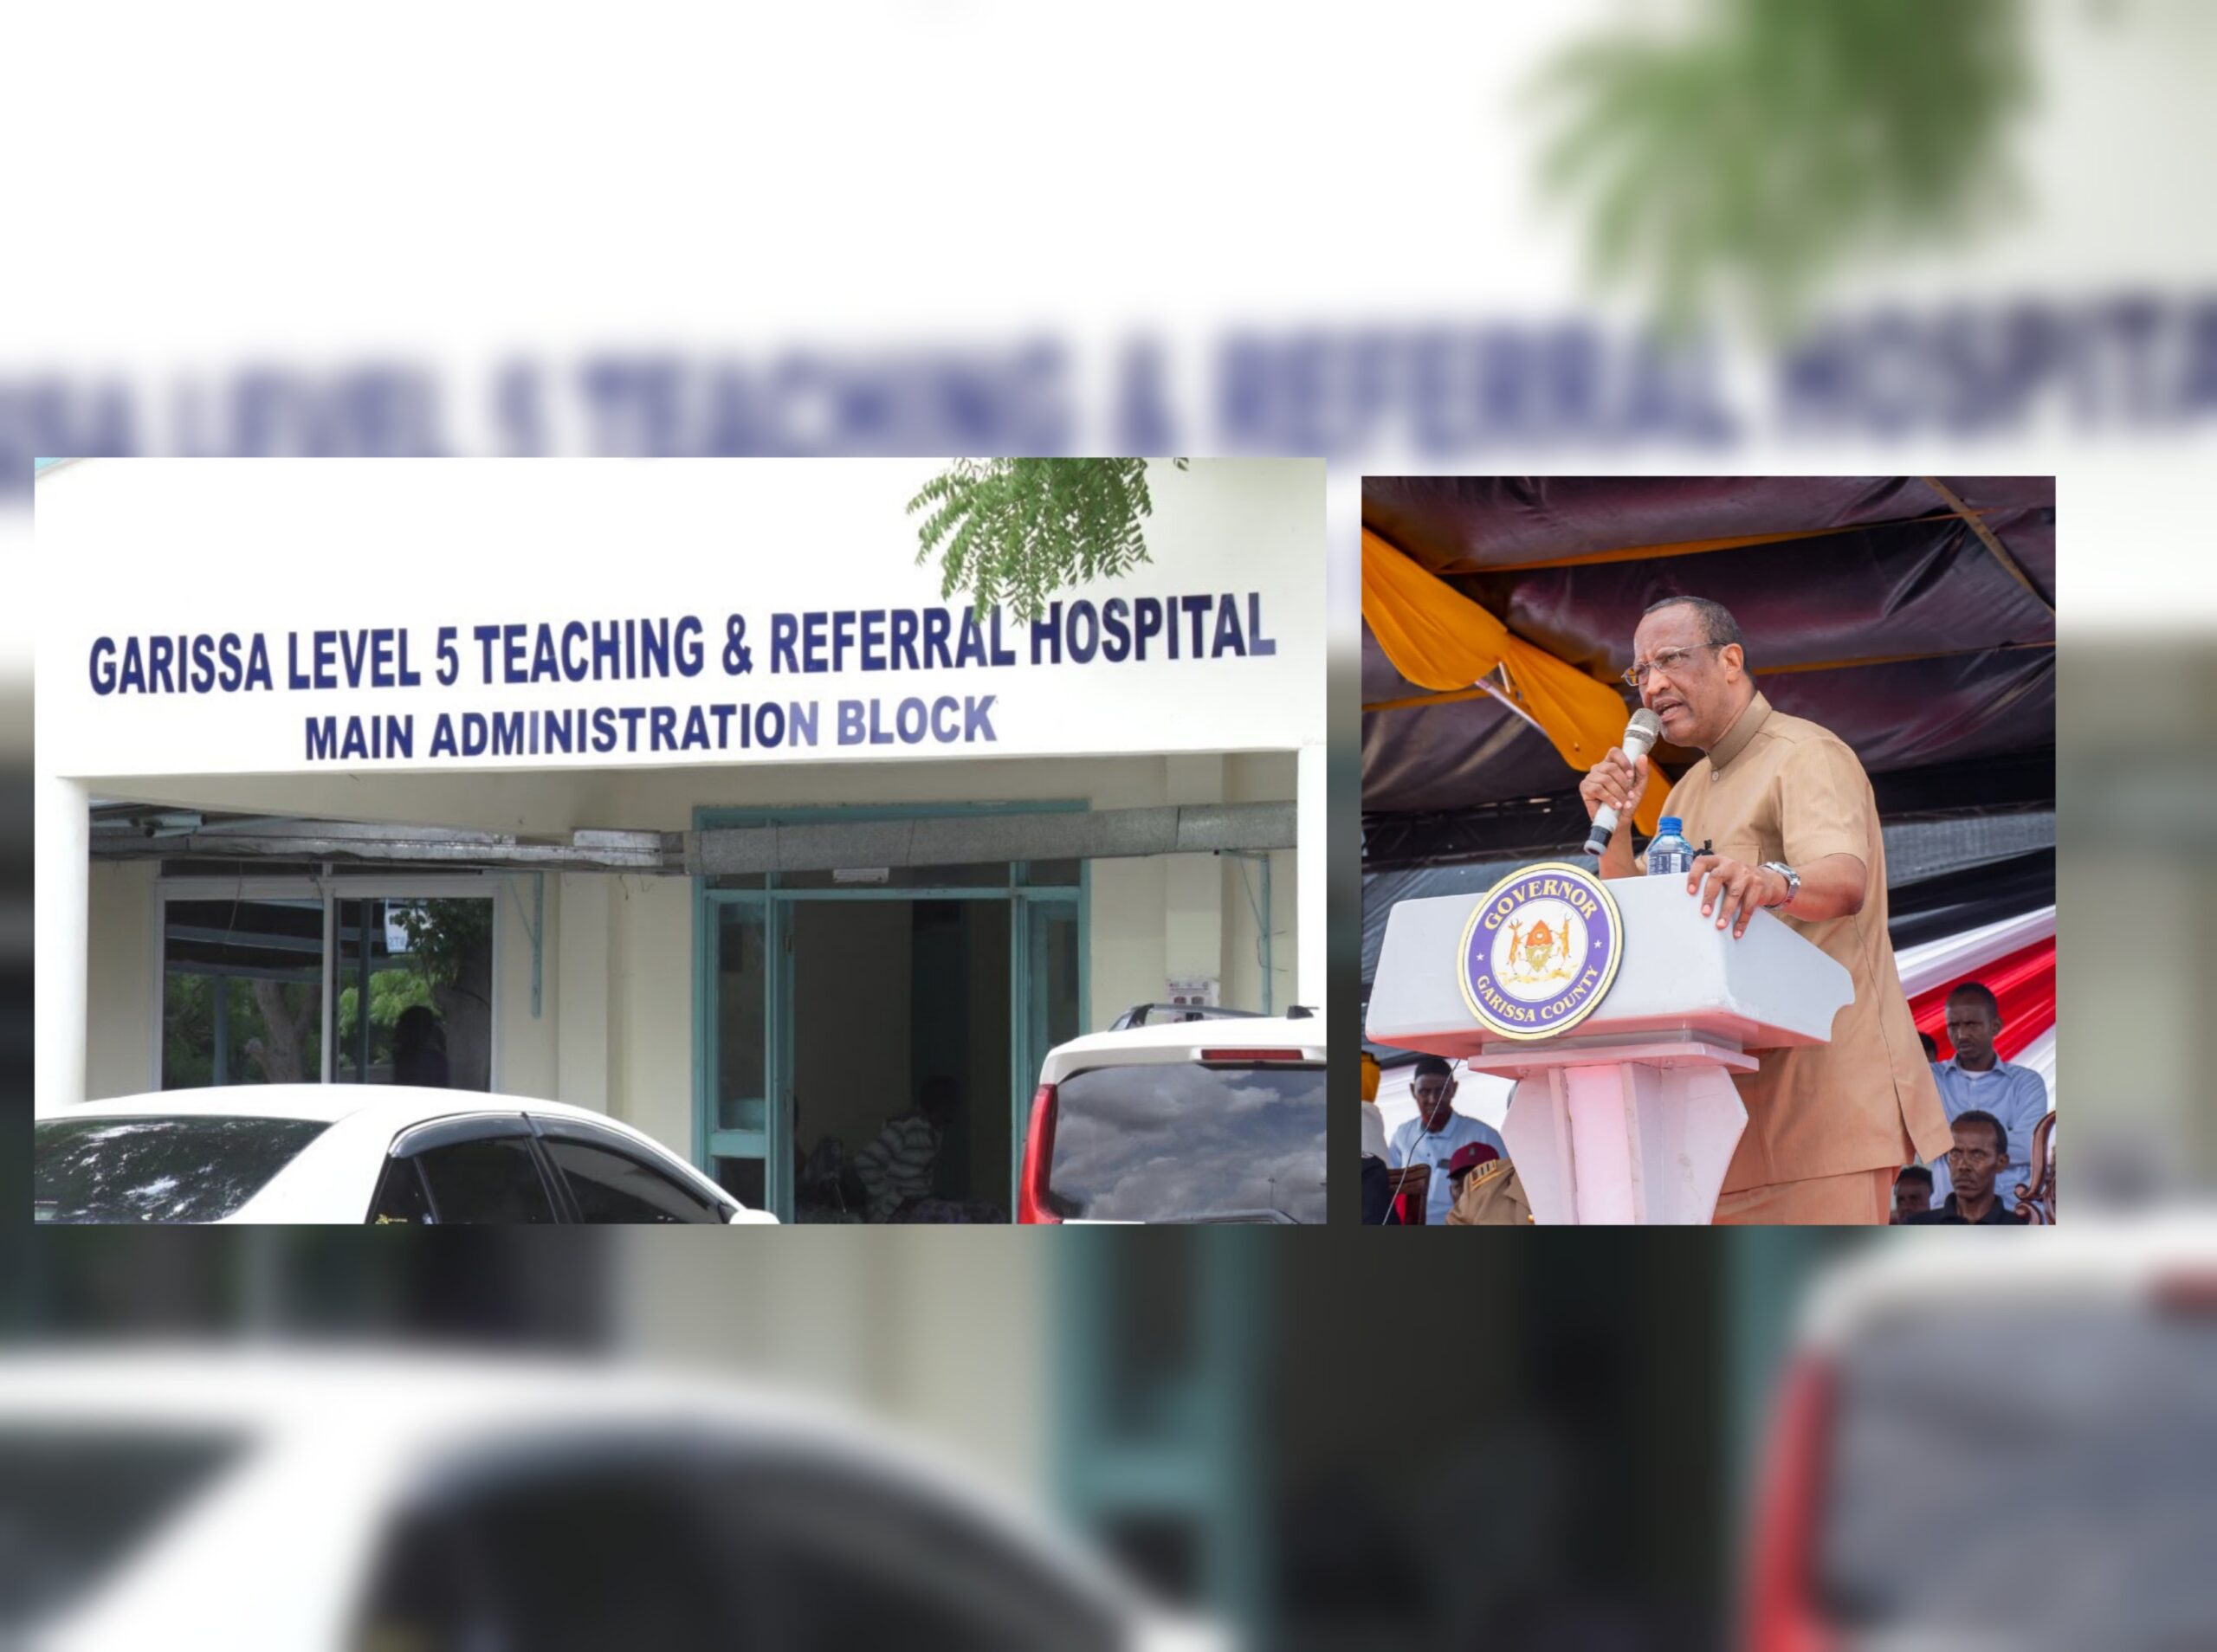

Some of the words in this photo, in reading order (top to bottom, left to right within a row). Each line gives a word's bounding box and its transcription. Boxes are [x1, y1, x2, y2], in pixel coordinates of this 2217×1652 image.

[90, 633, 273, 695] GARISSA
[288, 629, 421, 690] LEVEL
[436, 626, 460, 686] 5
[474, 616, 704, 684] TEACHING
[721, 613, 753, 675] &
[771, 604, 1016, 674] REFERRAL
[1031, 591, 1277, 665] HOSPITAL
[306, 715, 414, 760] MAIN
[430, 702, 818, 758] ADMINISTRATION
[837, 695, 998, 745] BLOCK
[1484, 879, 1598, 930] GOVERNOR
[1477, 975, 1536, 1023] GARISSA
[1541, 965, 1599, 1019] COUNTY
